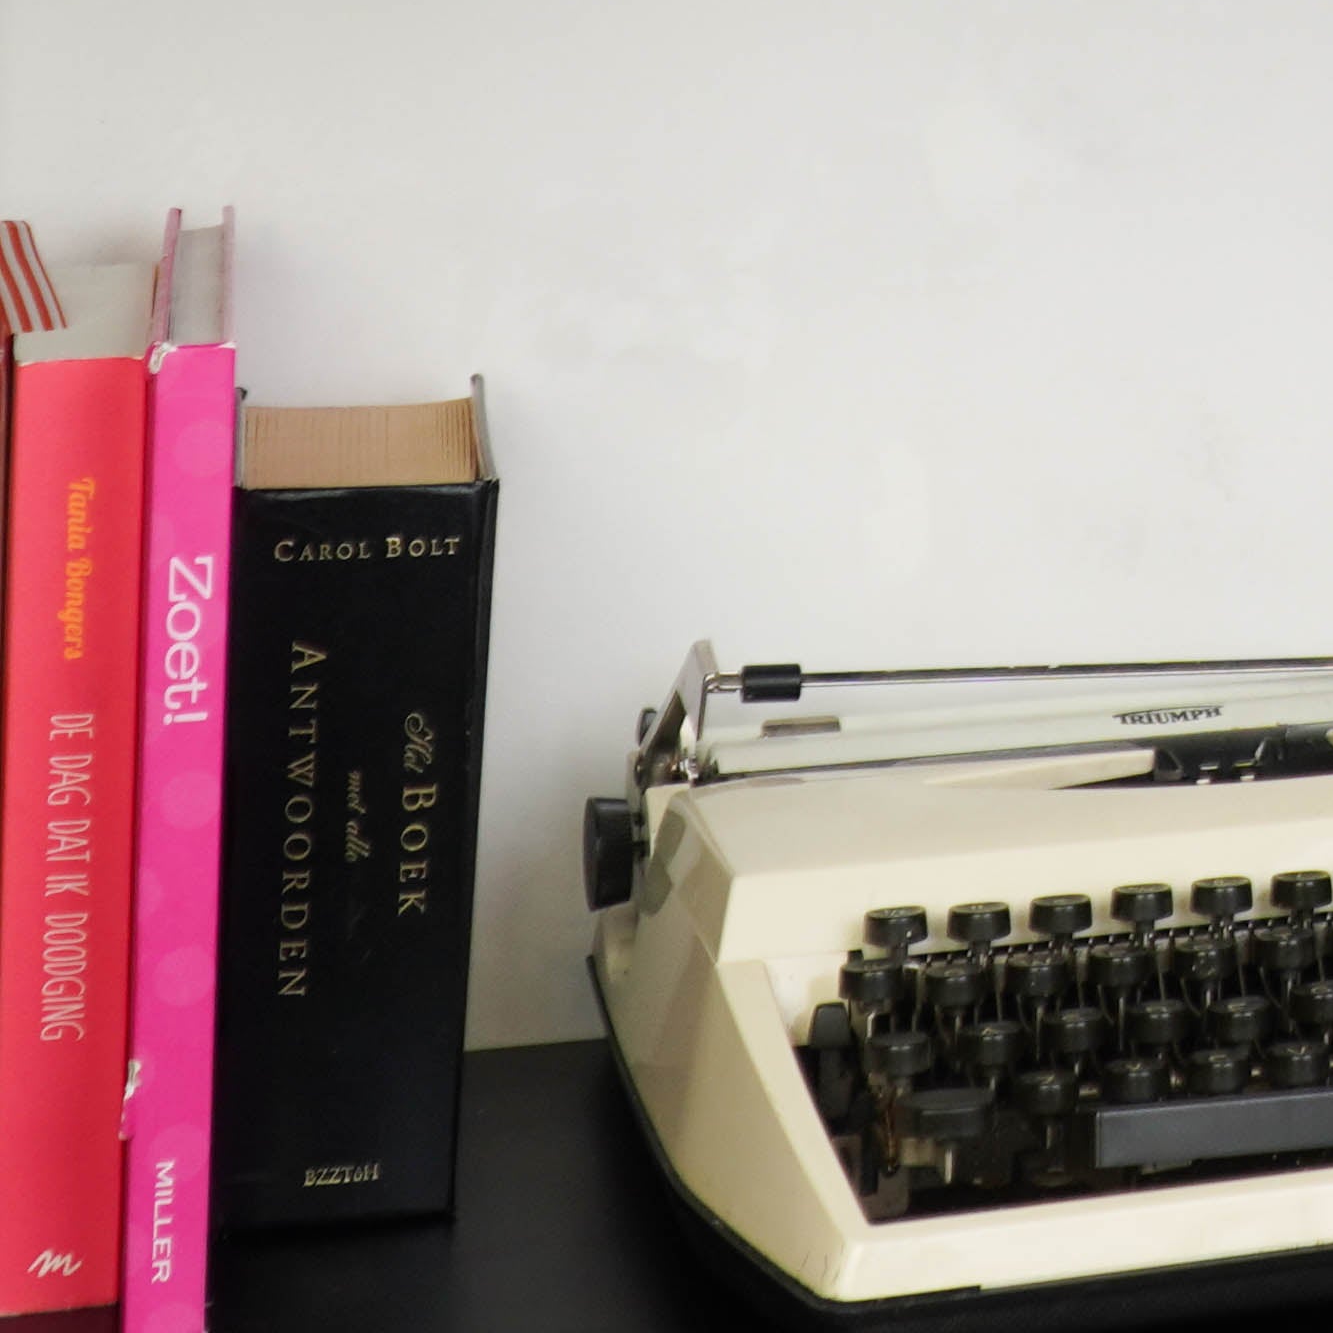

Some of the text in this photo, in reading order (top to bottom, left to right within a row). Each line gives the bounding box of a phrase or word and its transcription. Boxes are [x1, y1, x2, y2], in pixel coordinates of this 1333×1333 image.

[57, 477, 96, 661] Tania Bongers
[273, 536, 461, 563] CAROL BOLT
[163, 554, 214, 726] Zoet!
[1112, 705, 1225, 726] TRIUMPH
[39, 713, 95, 1042] DE DAG DAT IK DOODGING
[278, 640, 327, 997] ANTWOORDEN
[398, 783, 438, 917] BOEK
[151, 1159, 176, 1283] MILLER
